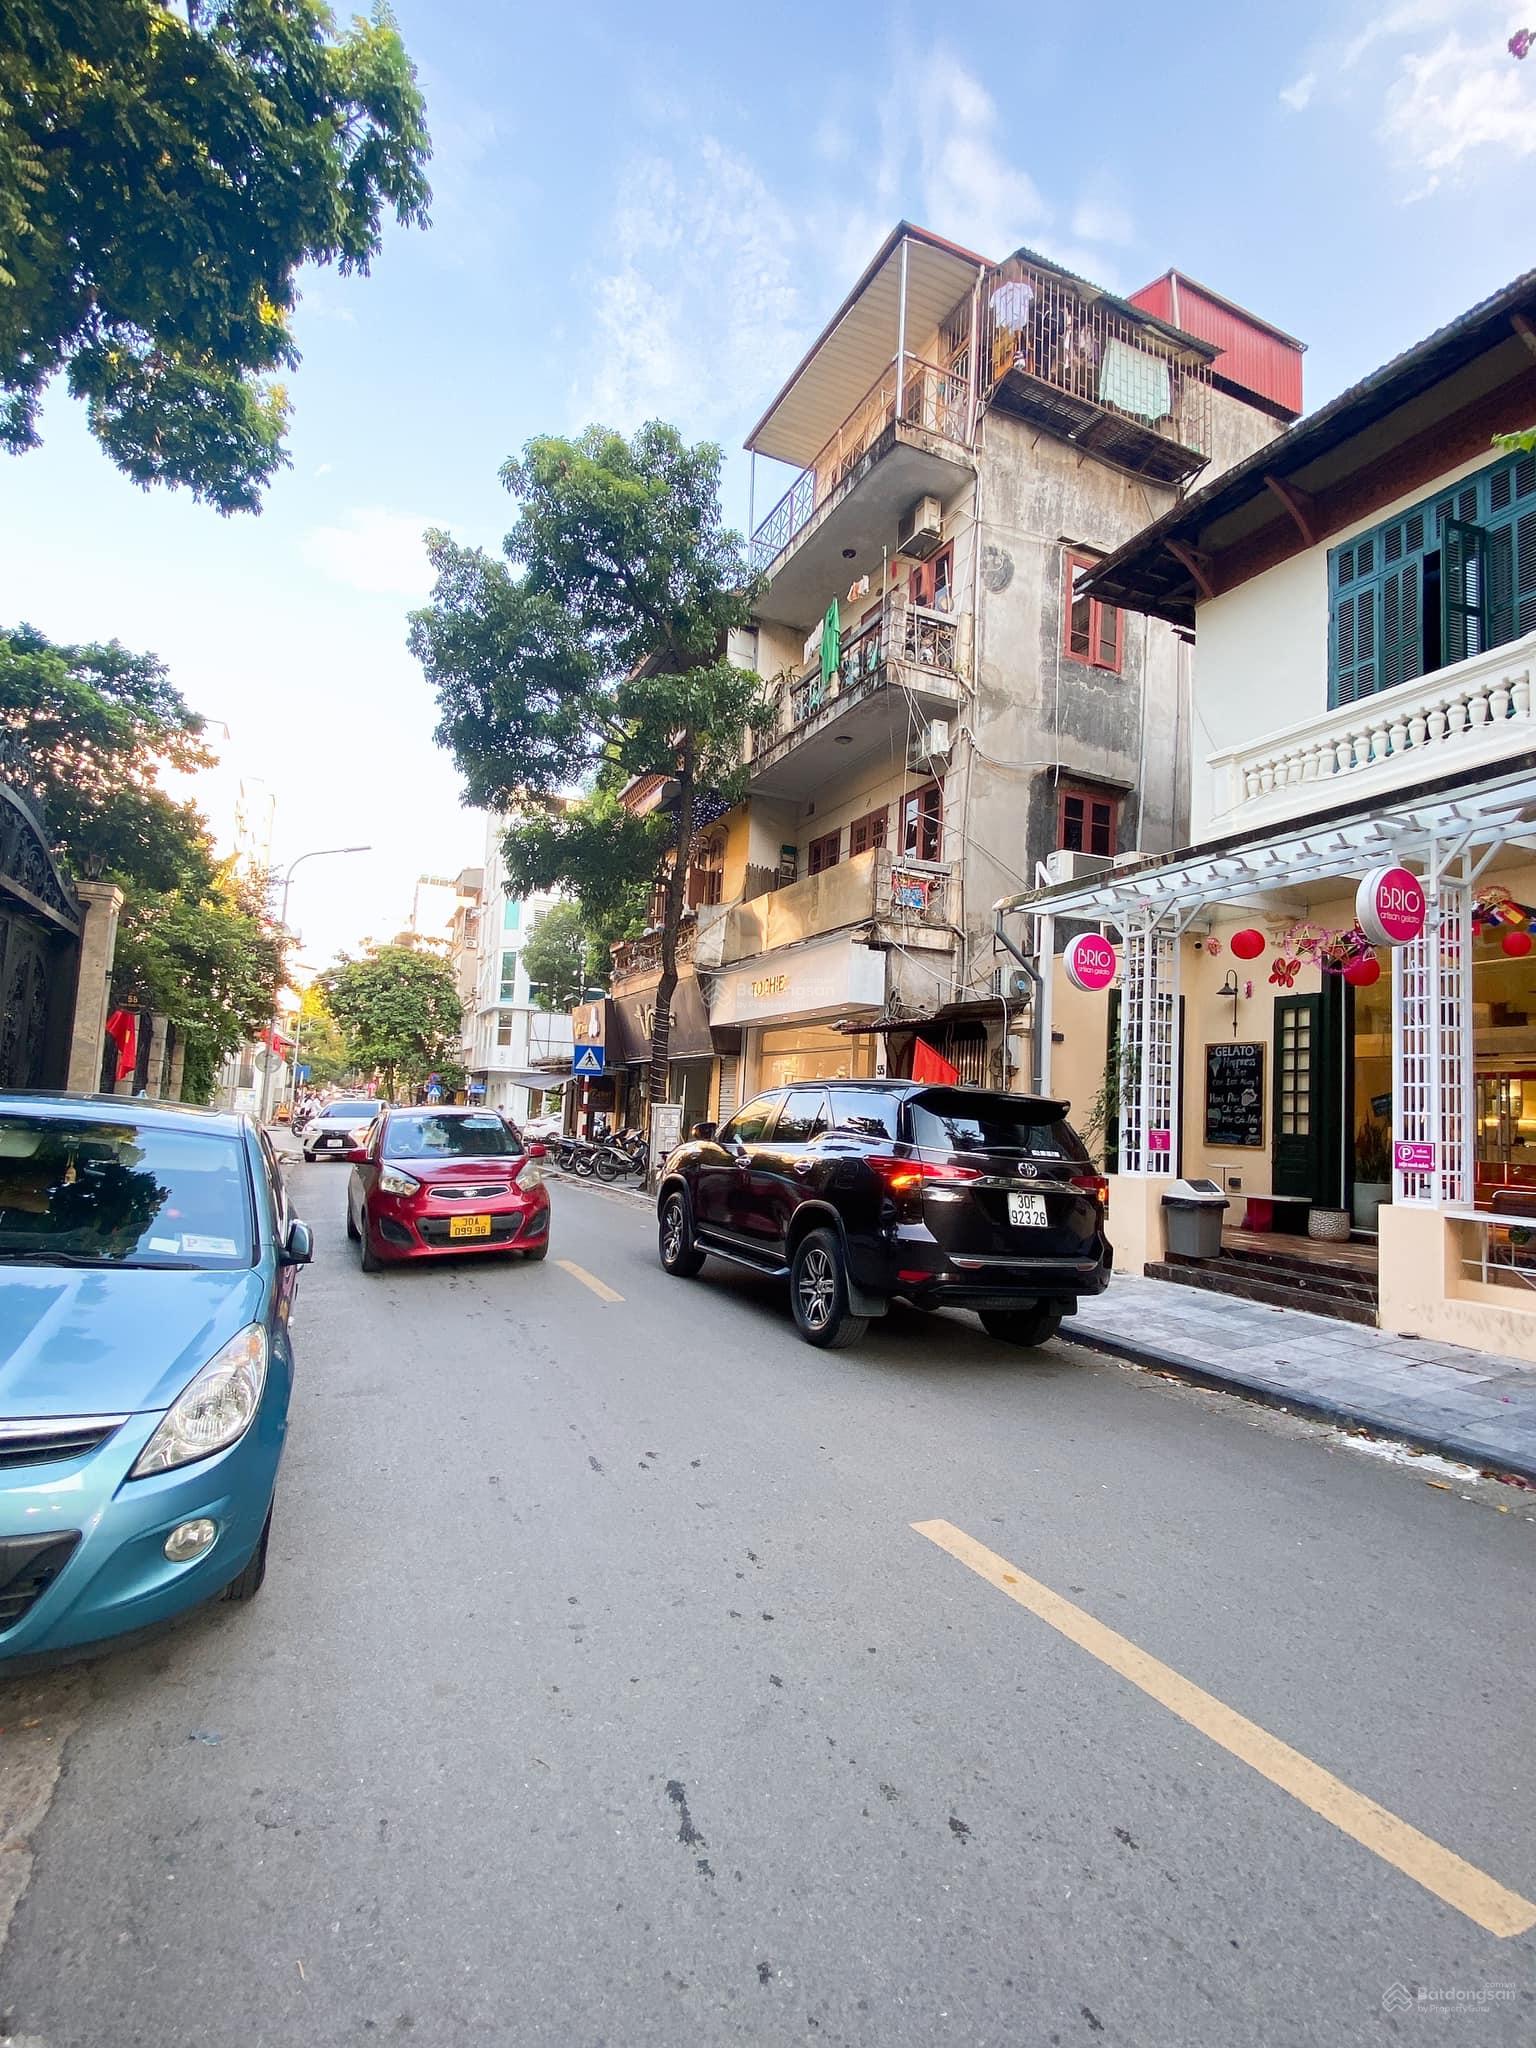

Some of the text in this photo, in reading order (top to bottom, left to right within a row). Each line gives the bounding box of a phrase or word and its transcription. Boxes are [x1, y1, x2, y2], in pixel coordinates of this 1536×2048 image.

[1379, 886, 1420, 912] BRIO
[1380, 911, 1420, 924] artisan gelato
[1077, 948, 1111, 967] BRIO
[1215, 1046, 1255, 1057] GELATO
[1402, 1147, 1411, 1158] P
[1017, 1195, 1036, 1209] 30F
